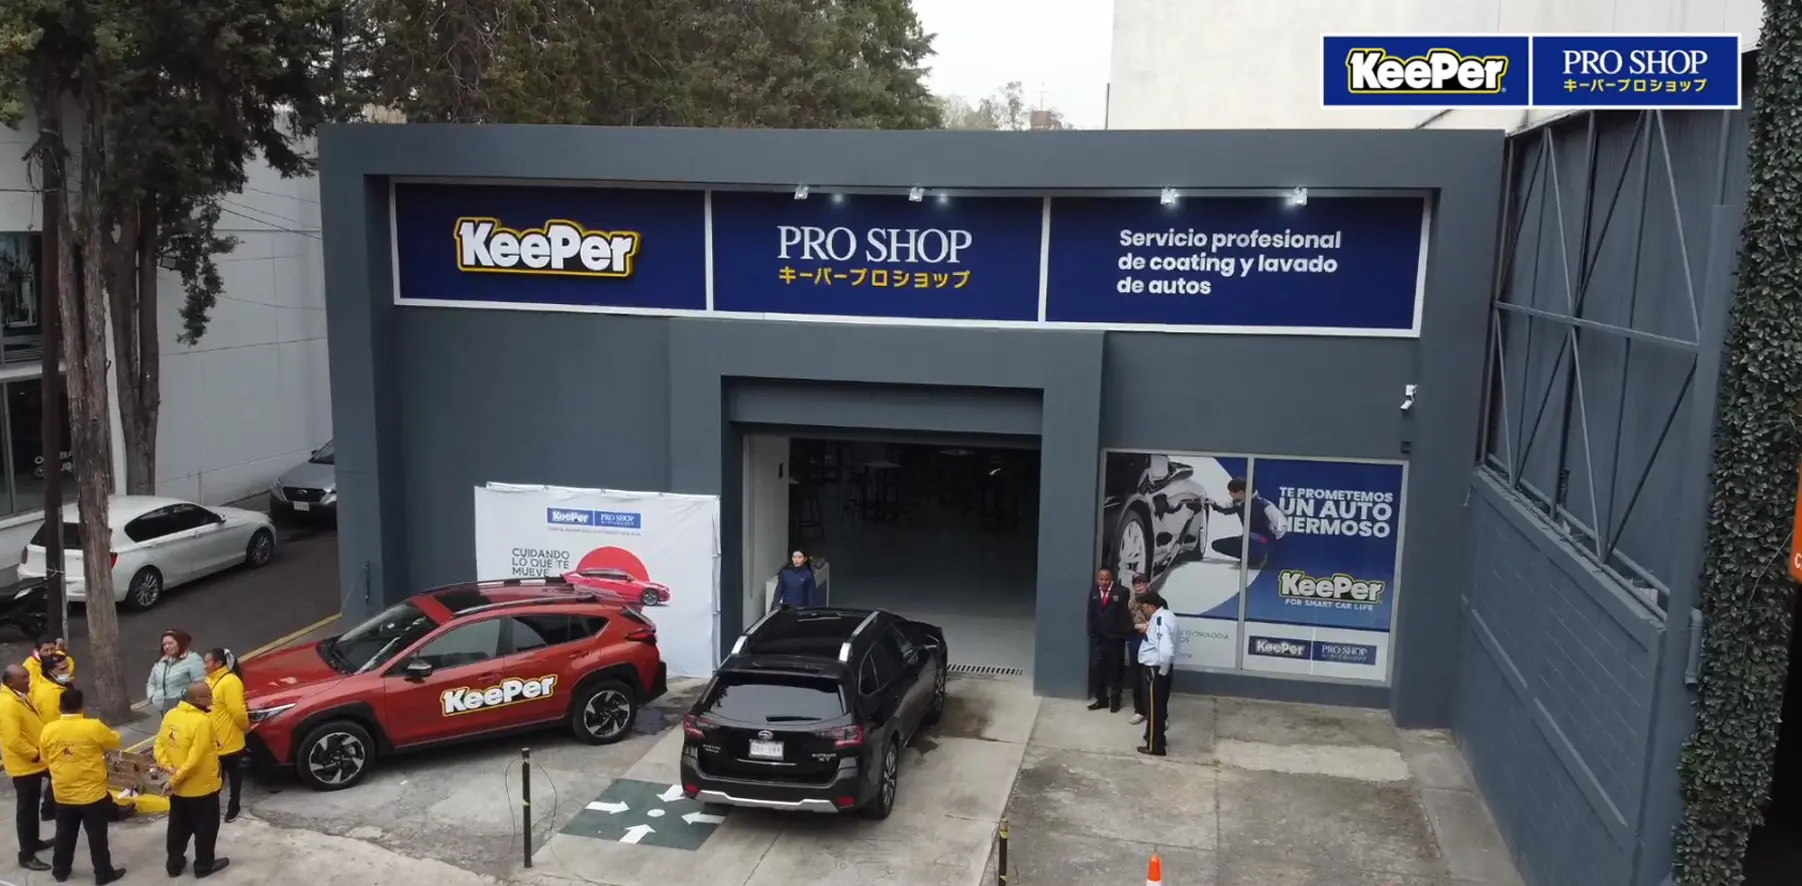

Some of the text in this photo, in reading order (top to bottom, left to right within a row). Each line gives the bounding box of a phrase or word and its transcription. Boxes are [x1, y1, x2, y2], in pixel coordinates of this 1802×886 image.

[458, 220, 634, 272] KeePer
[776, 225, 973, 264] PRO SHOP
[1119, 228, 1342, 253] Servicio profesional
[1117, 252, 1339, 277] de coating y lavado
[778, 265, 971, 289] キーパープロショップ
[1116, 276, 1212, 295] de autos
[1279, 486, 1394, 503] TE PROMETEMOS
[1279, 497, 1393, 521] UN AUTO
[511, 547, 570, 560] CUIDANDO
[511, 557, 570, 570] LO QUE TE
[511, 566, 551, 578] MUEVE
[1280, 571, 1384, 601] KeePer
[1284, 598, 1302, 606] FOR
[1304, 599, 1333, 609] SMART
[1335, 602, 1353, 610] CAR
[1255, 640, 1306, 657] KeePer
[1321, 644, 1368, 656] PRO SHOP
[442, 676, 555, 714] KeePer
